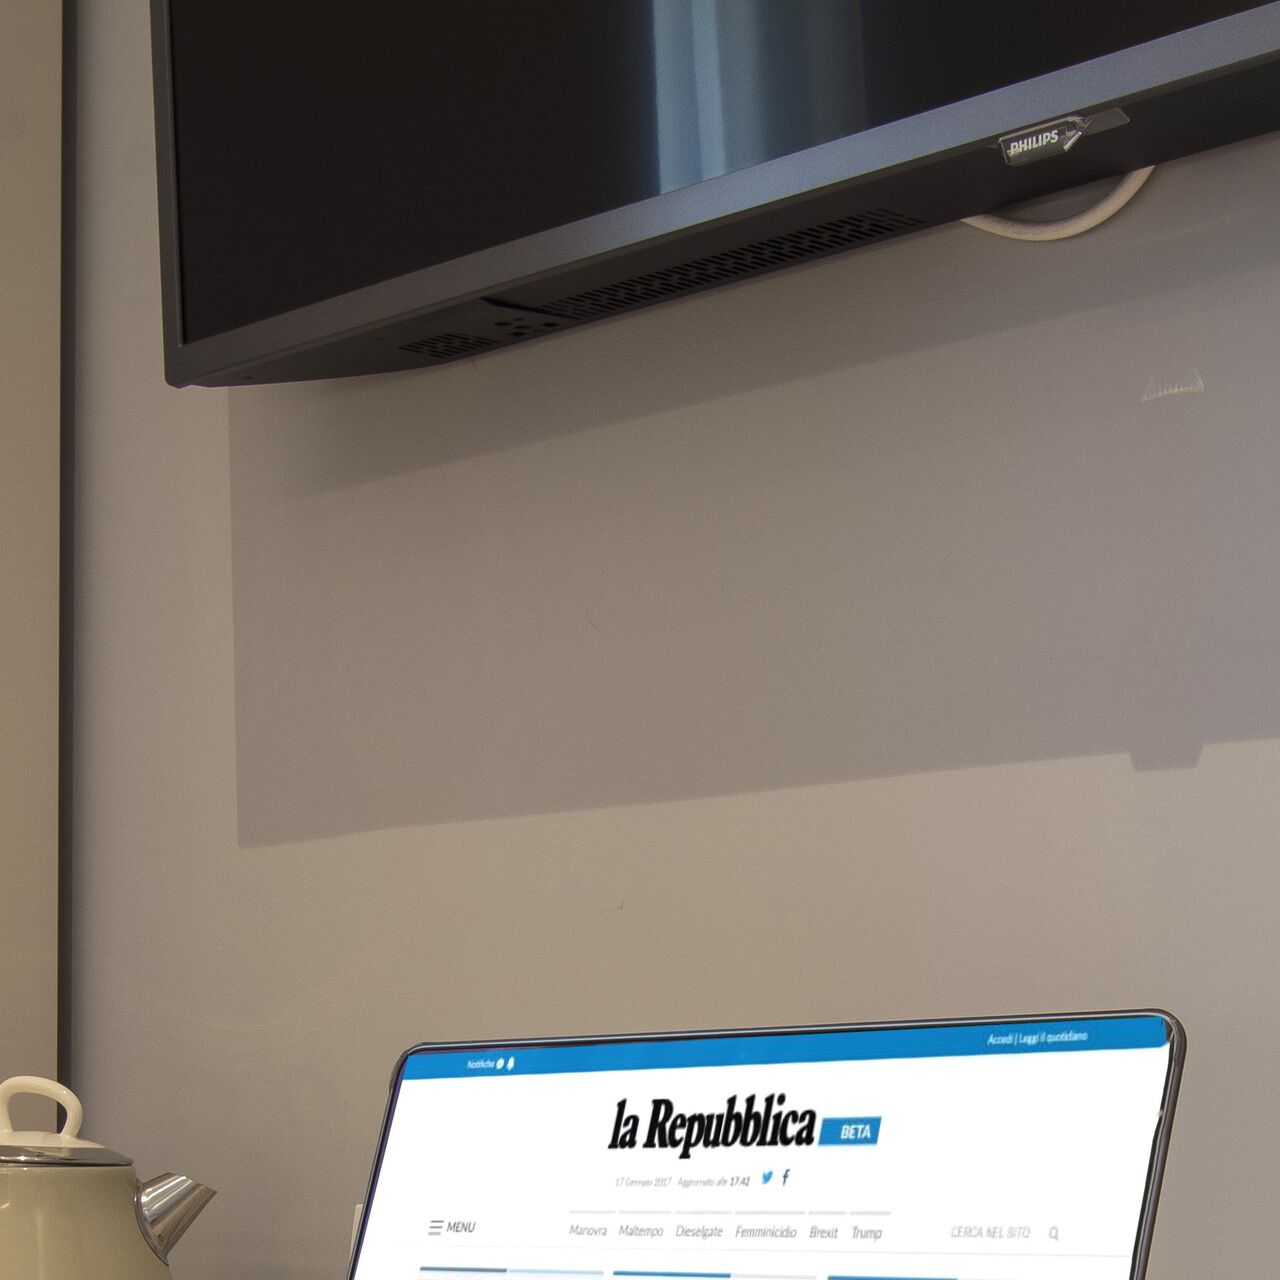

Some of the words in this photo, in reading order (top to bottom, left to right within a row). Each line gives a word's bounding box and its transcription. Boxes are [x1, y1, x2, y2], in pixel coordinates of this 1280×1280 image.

[1008, 130, 1059, 155] PHILIPS
[608, 1098, 639, 1149] la
[642, 1093, 817, 1159] Repubblica
[840, 1124, 871, 1139] BETA
[446, 1221, 475, 1233] MENU
[569, 1225, 607, 1237] Manovra
[619, 1225, 664, 1239] Maltempo
[675, 1225, 723, 1240] Dieselgate
[735, 1226, 797, 1238] Femminicidio
[810, 1225, 838, 1239] Brexit
[852, 1226, 882, 1242] Trump
